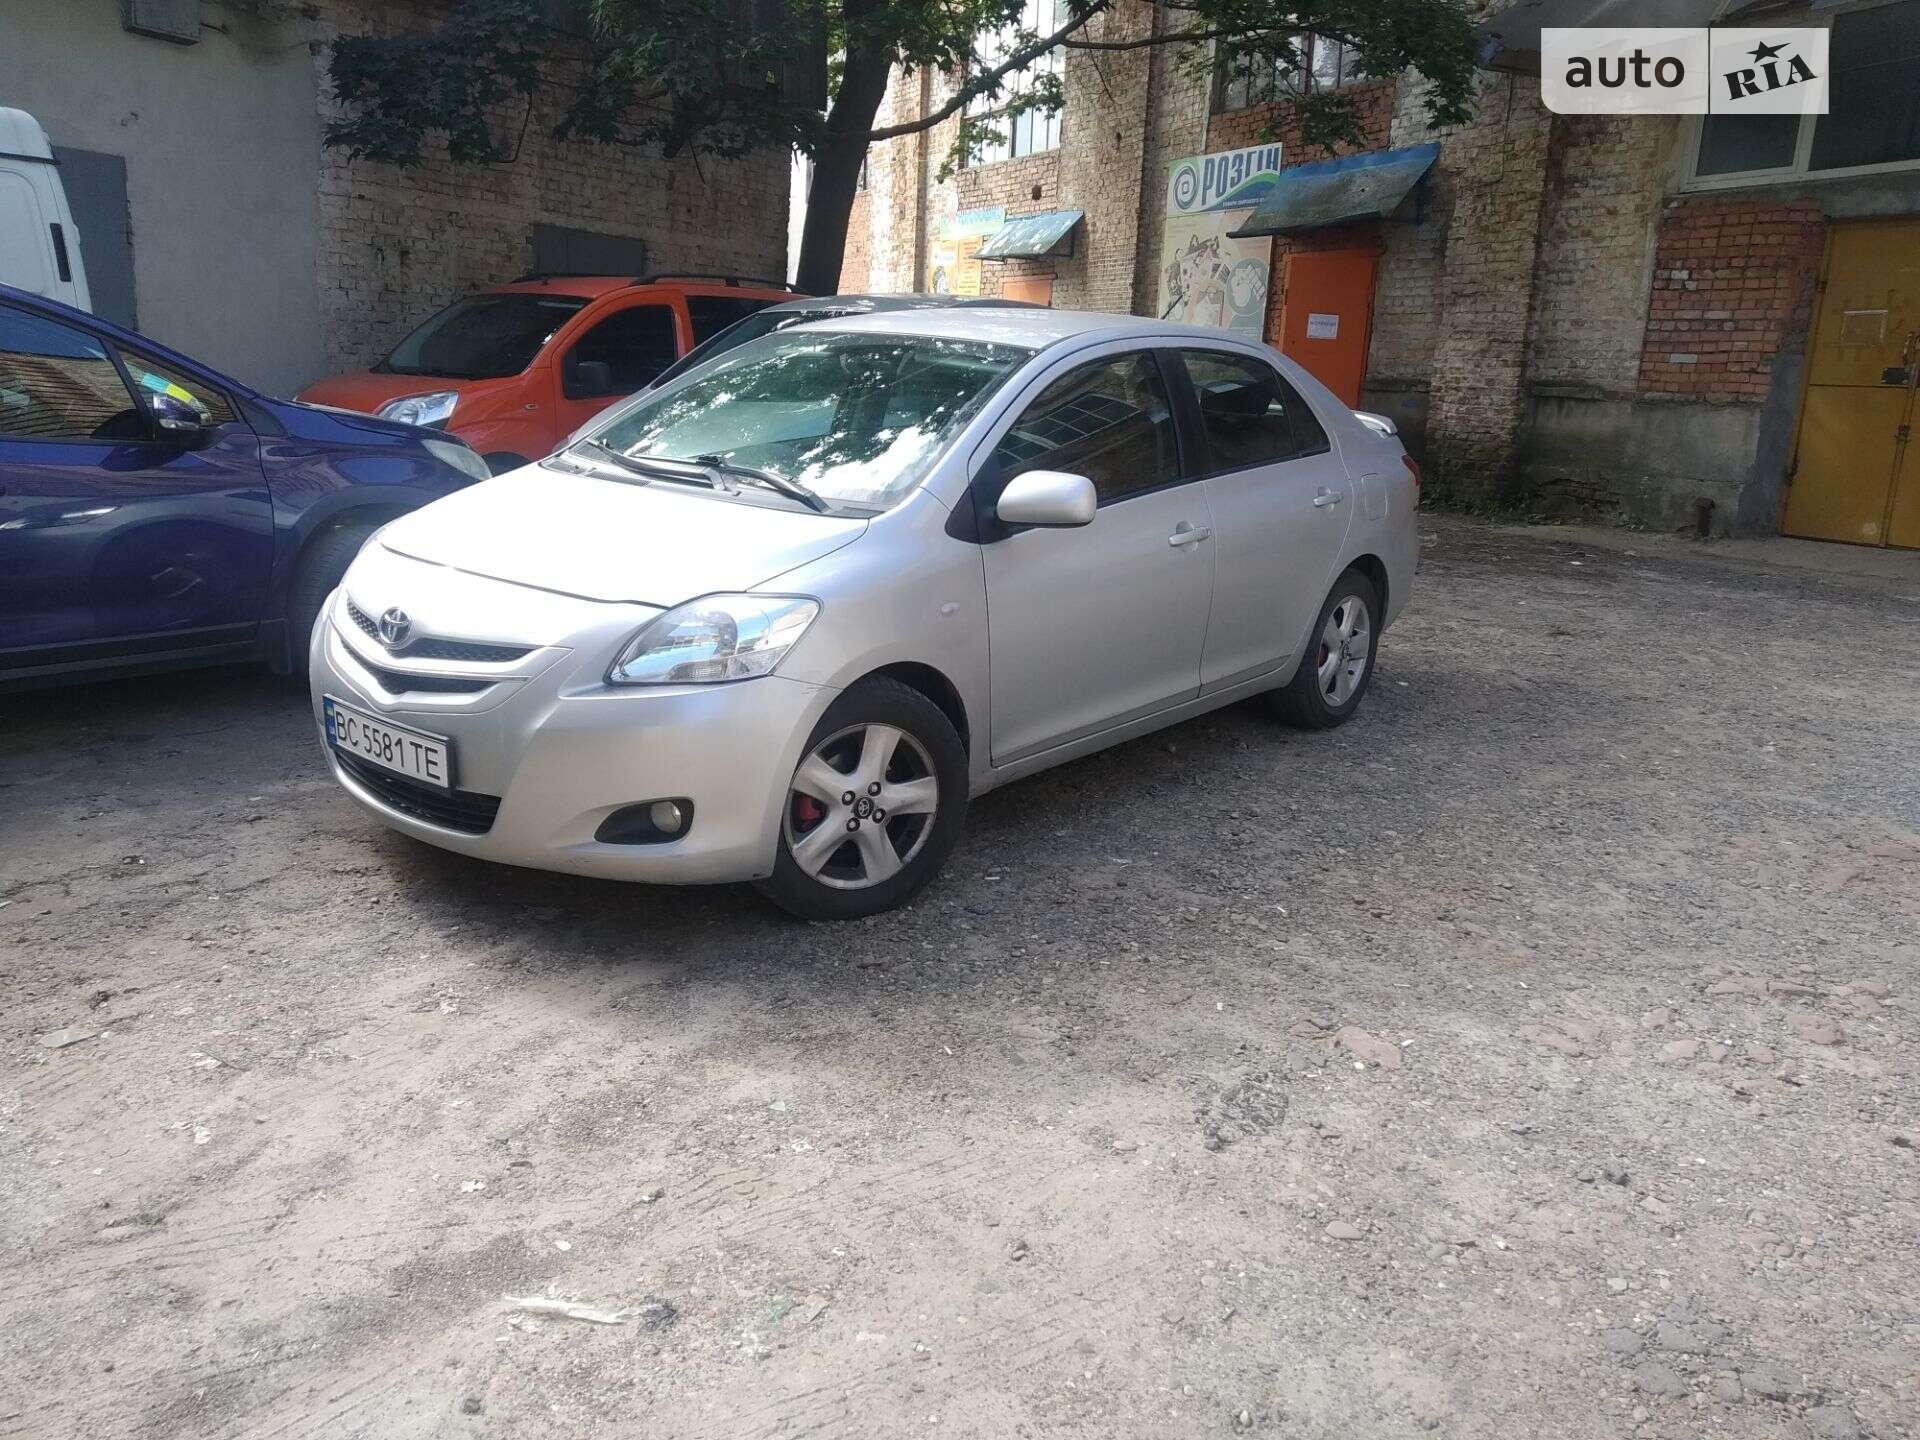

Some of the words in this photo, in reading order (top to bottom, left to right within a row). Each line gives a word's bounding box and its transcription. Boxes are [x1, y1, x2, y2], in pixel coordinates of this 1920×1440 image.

[335, 711, 359, 746] BC
[362, 723, 405, 768] 5581
[409, 741, 441, 780] TE
